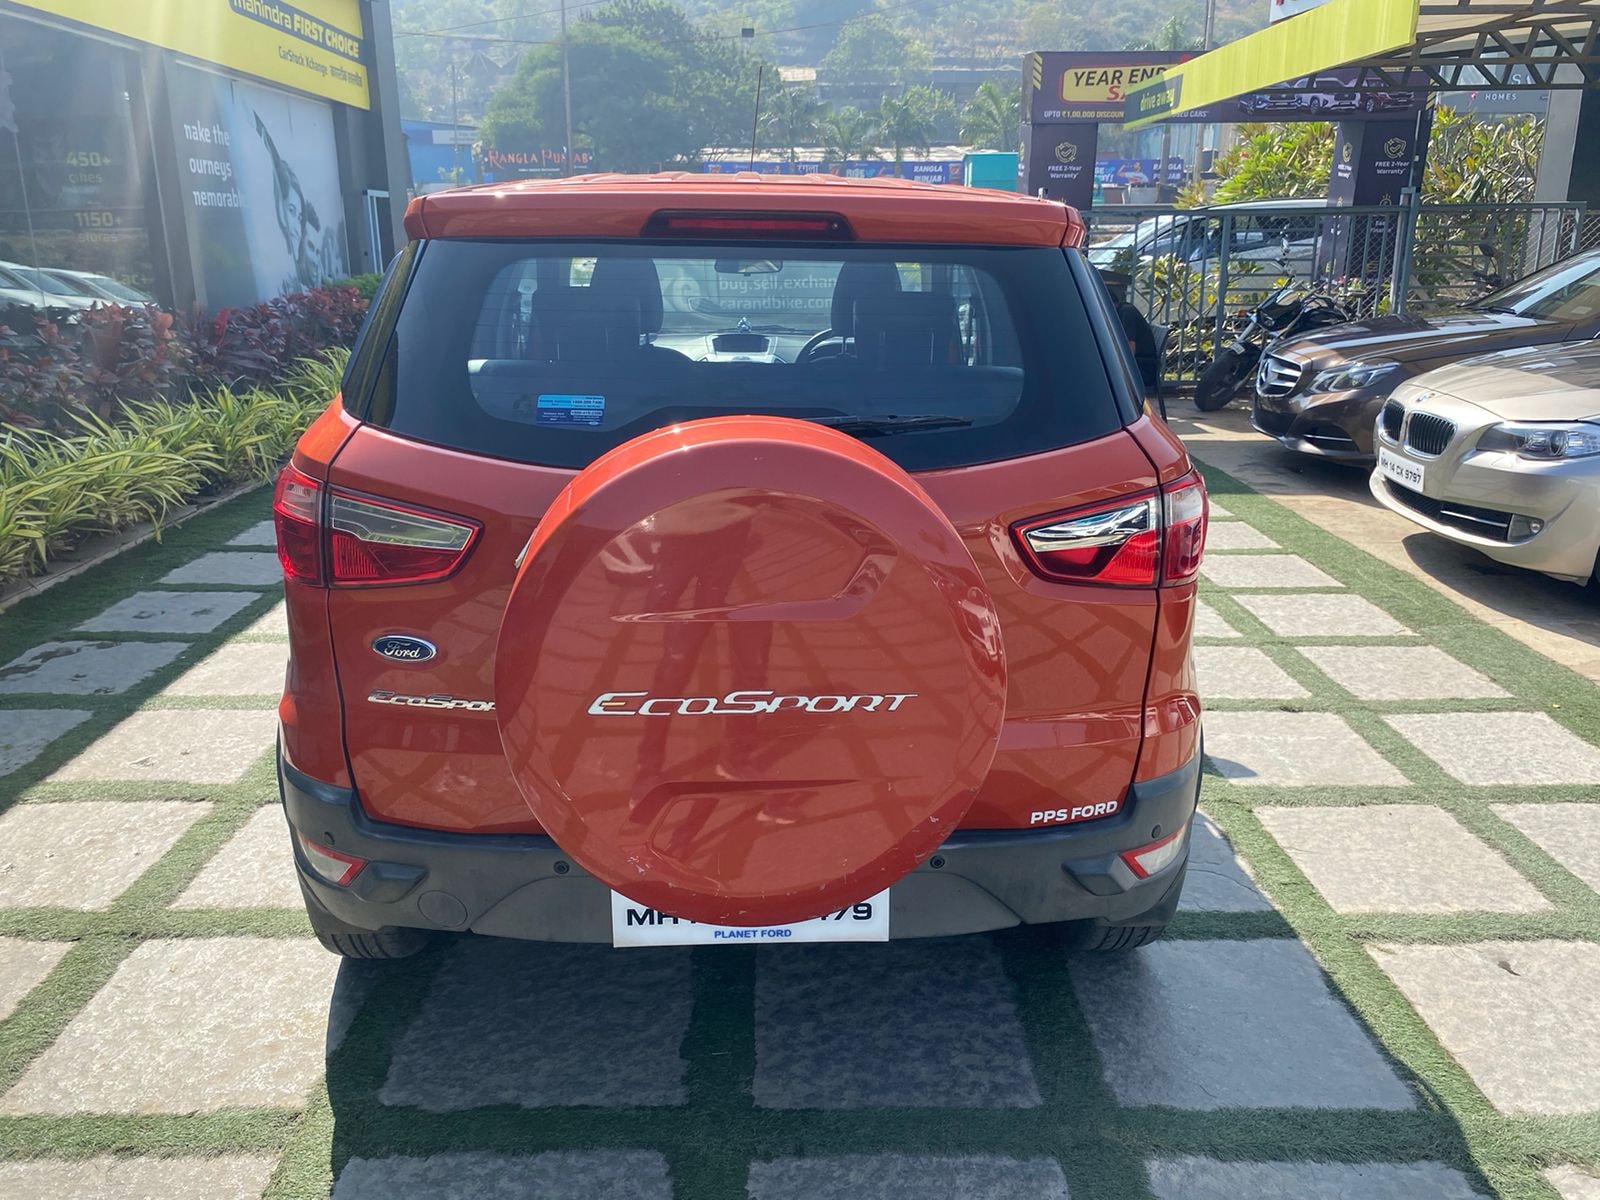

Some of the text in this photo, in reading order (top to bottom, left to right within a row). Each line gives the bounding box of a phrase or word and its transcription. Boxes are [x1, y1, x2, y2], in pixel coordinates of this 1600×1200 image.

[293, 13, 324, 43] FIRST
[325, 28, 360, 58] CHOICE
[1074, 70, 1123, 87] YEAR
[1107, 85, 1126, 101] S
[1484, 92, 1518, 101] HOMES
[1141, 92, 1156, 112] drive
[1043, 110, 1061, 118] UPTO
[212, 123, 231, 146] the
[66, 151, 112, 167] 450+
[487, 148, 589, 169] RANGLA PUAB
[914, 165, 943, 173] RANGLA
[1405, 469, 1421, 484] 9797
[384, 640, 421, 659] Ford
[1030, 800, 1118, 824] PPS FORD
[714, 929, 792, 939] PLANET FORD
